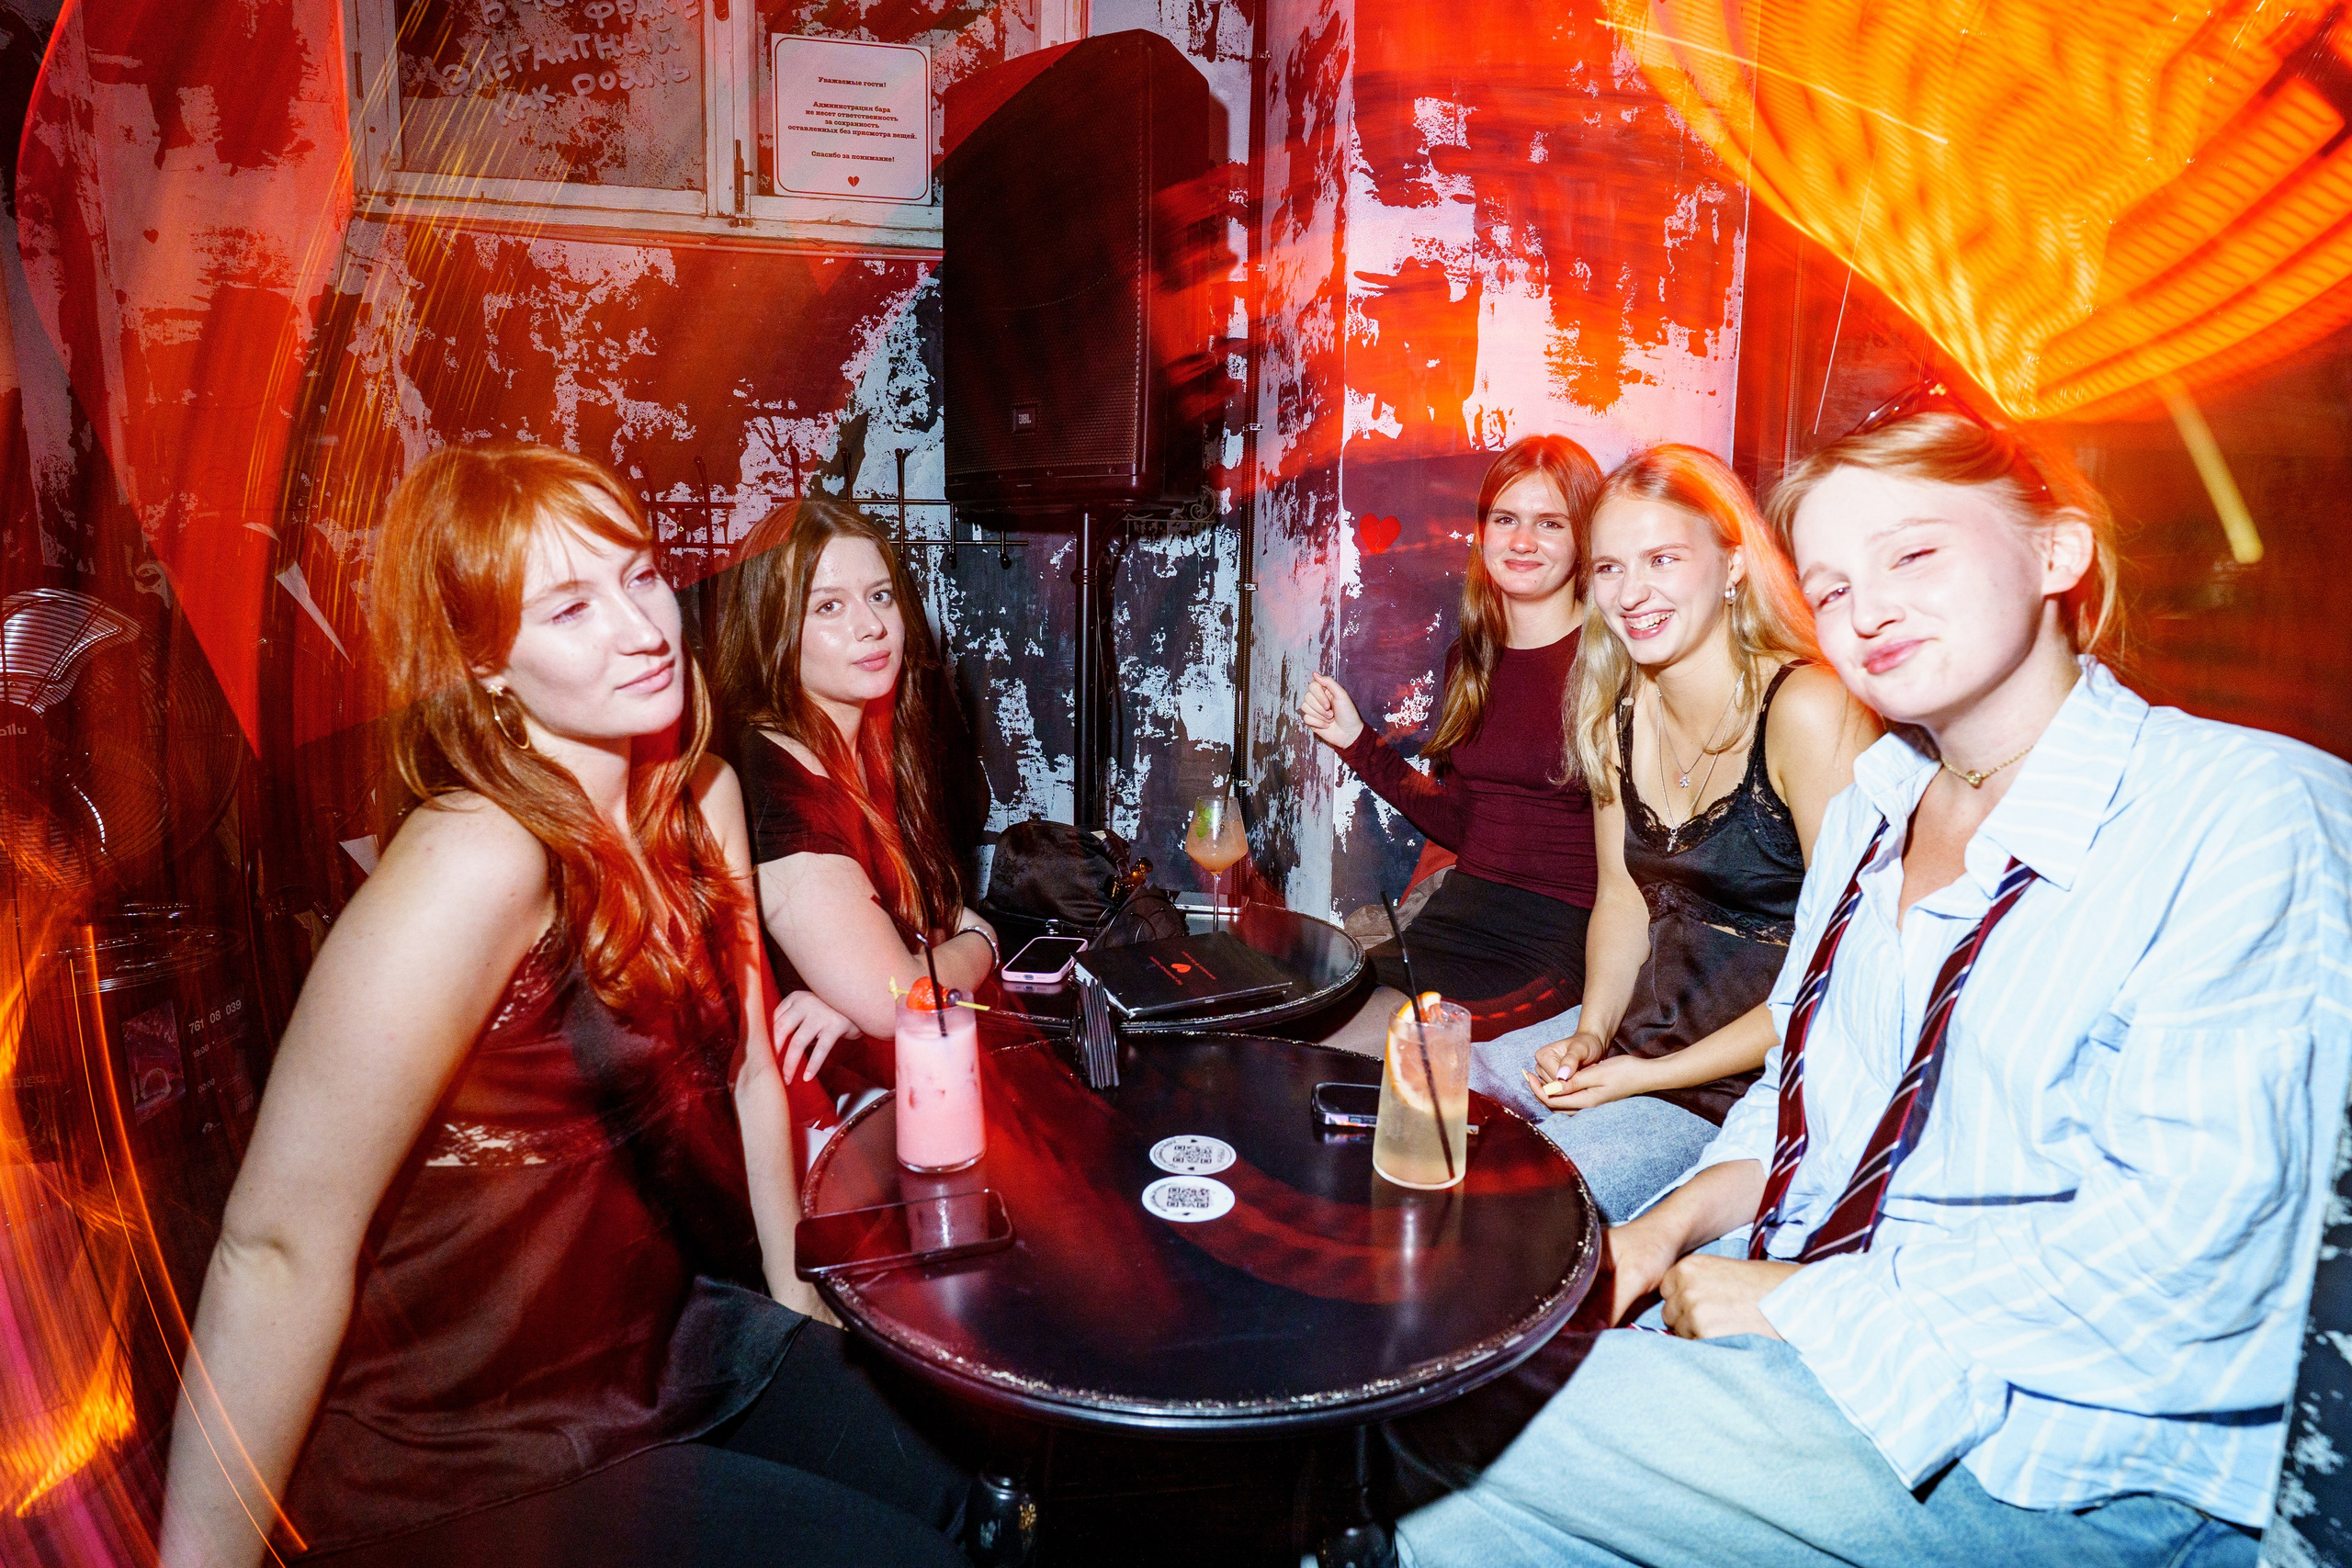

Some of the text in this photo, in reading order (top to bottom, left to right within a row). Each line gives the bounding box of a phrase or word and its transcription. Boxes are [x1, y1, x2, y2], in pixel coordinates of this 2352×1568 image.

[442, 26, 682, 96] ЭЛЕГАНТНЫЙ
[818, 76, 887, 88] Уважаемые гости!
[812, 101, 891, 114] Администрация бара
[837, 112, 899, 121] ответственность
[834, 120, 880, 129] сохранность
[787, 125, 918, 140] оставленных без присмотра вещей.
[811, 151, 842, 159] Спасибо
[852, 154, 895, 163] понимание!
[1019, 413, 1032, 424] JBL
[188, 999, 242, 1034] 761 08 039
[198, 1077, 216, 1094] 00:00
